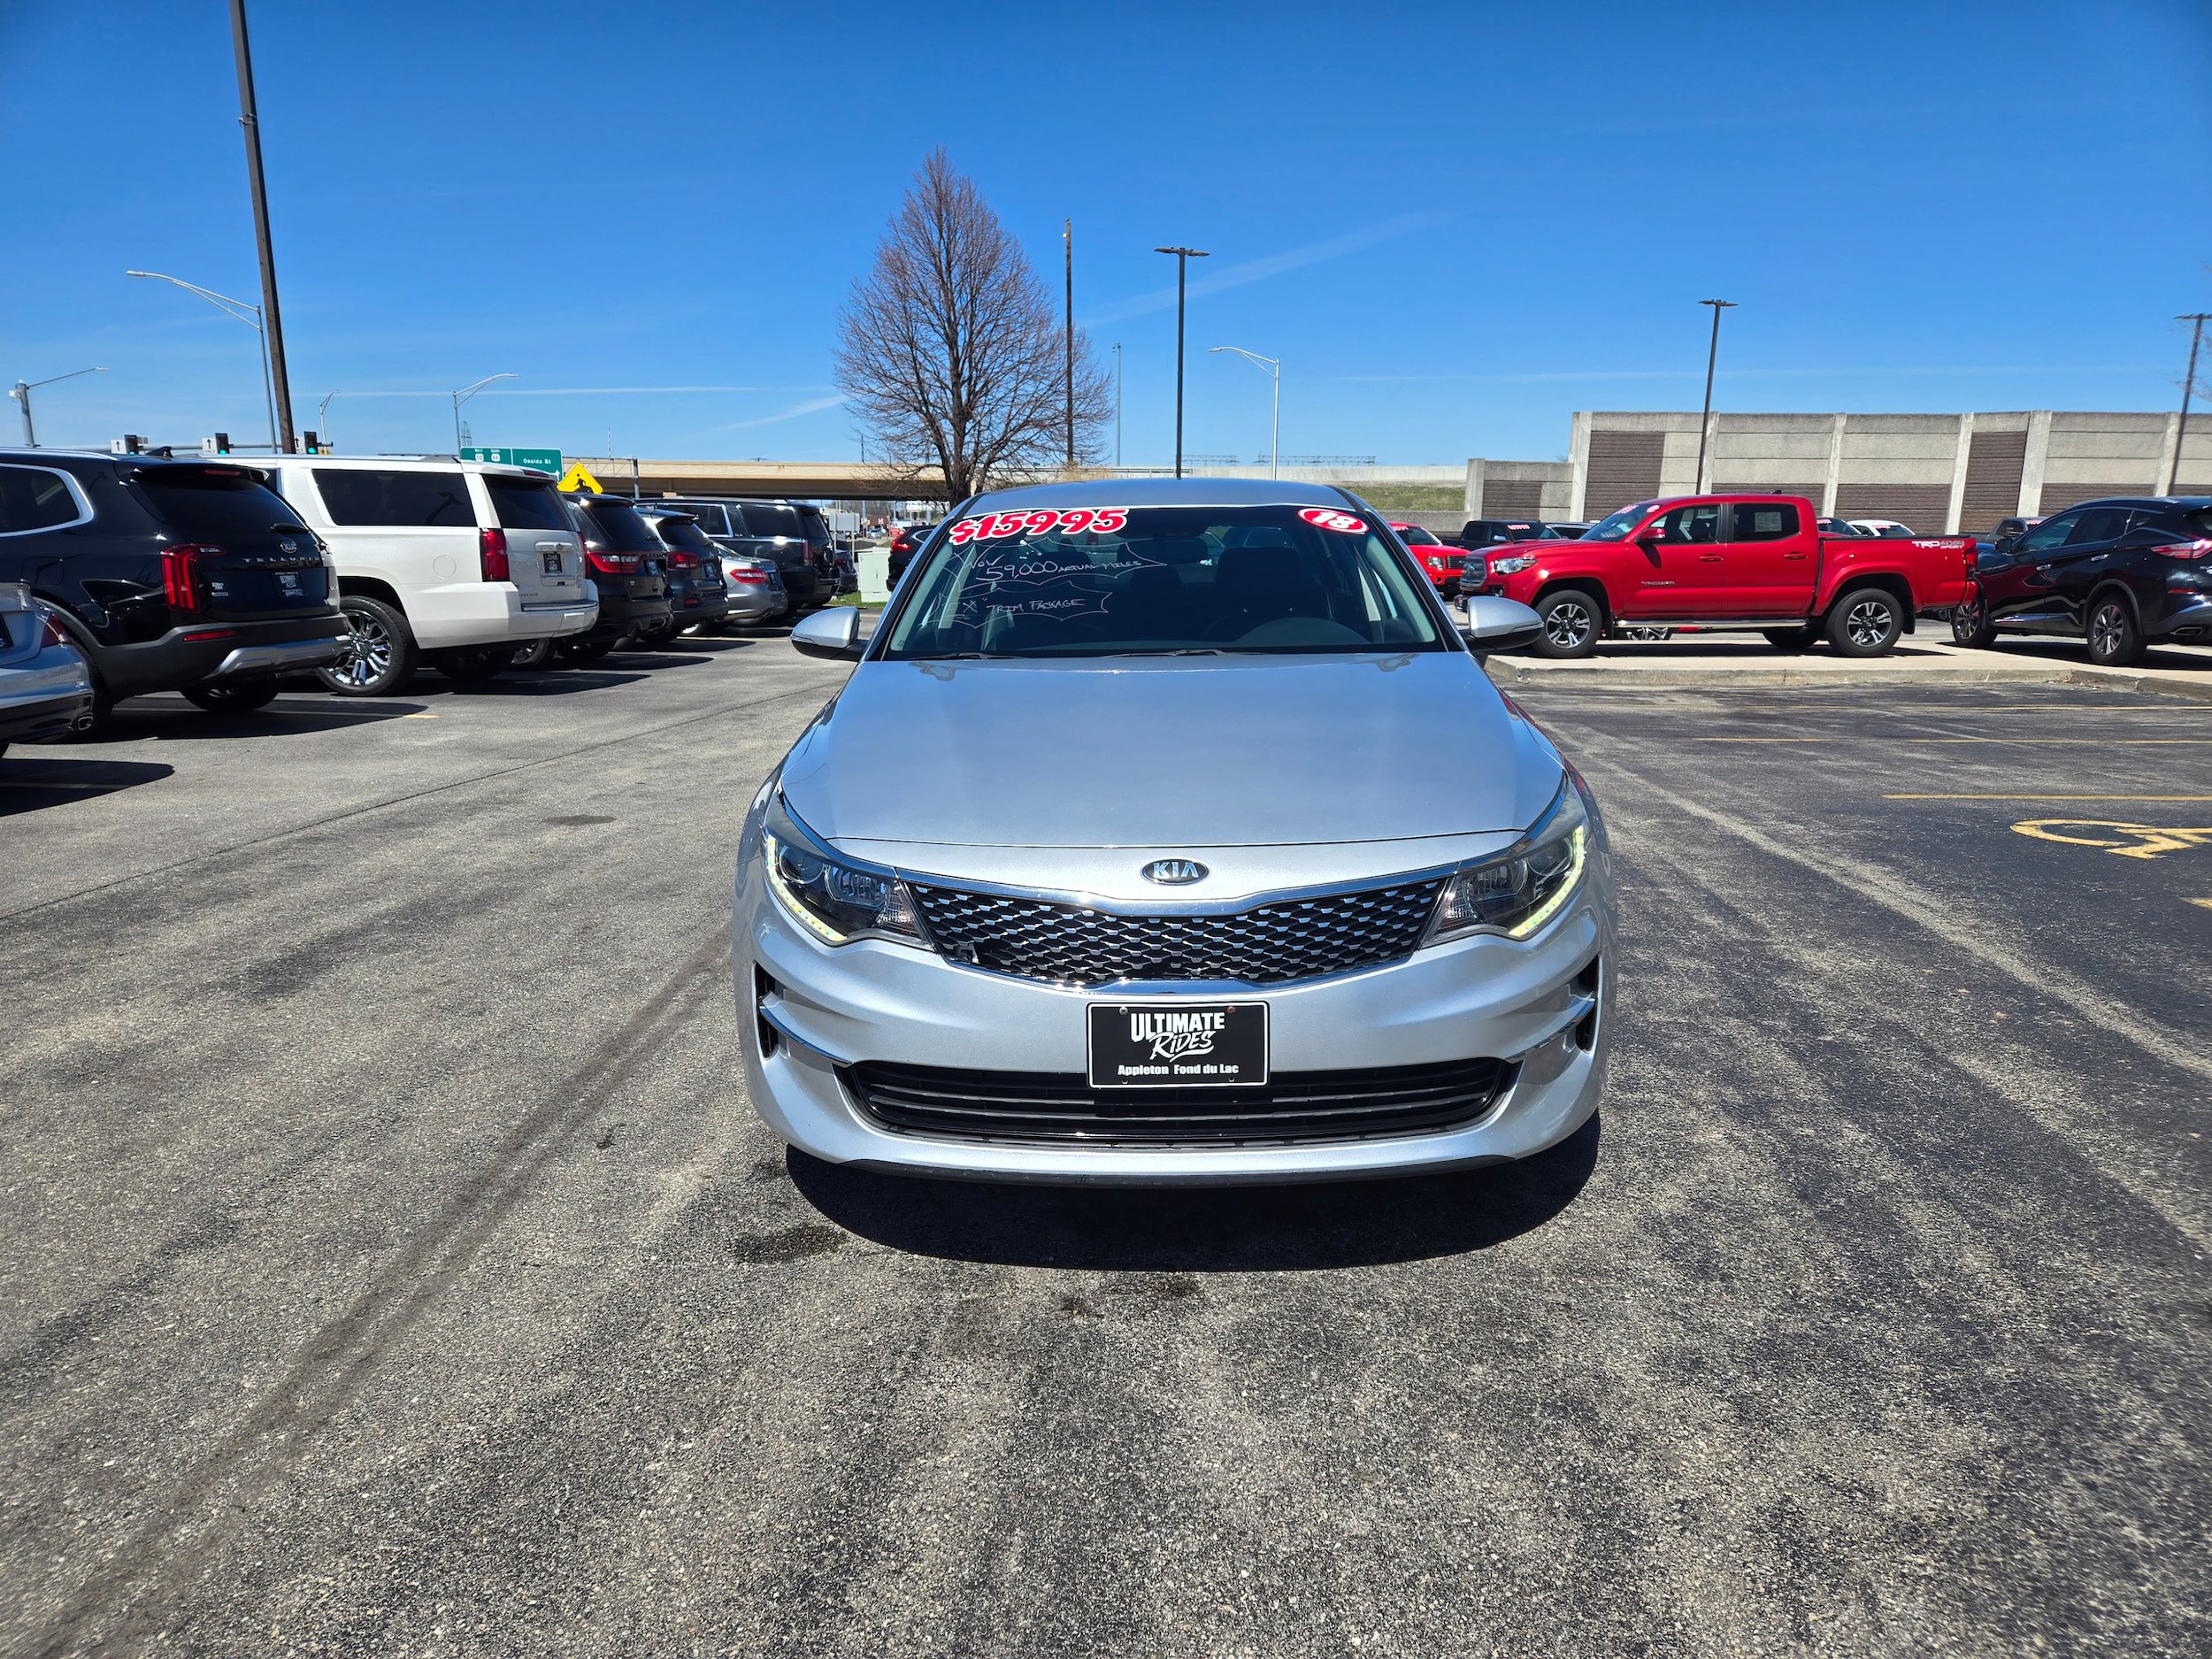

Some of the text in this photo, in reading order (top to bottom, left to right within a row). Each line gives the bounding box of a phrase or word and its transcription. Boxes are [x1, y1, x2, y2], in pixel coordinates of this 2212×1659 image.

[949, 508, 1129, 545] $15995
[1312, 511, 1358, 529] 18
[975, 560, 1058, 582] 59,000
[1028, 598, 1087, 611] PACKAGE
[1153, 861, 1200, 879] KIA
[1130, 1011, 1225, 1042] ULTIMATE
[1118, 1064, 1240, 1075] Appleton Fond du Lac
